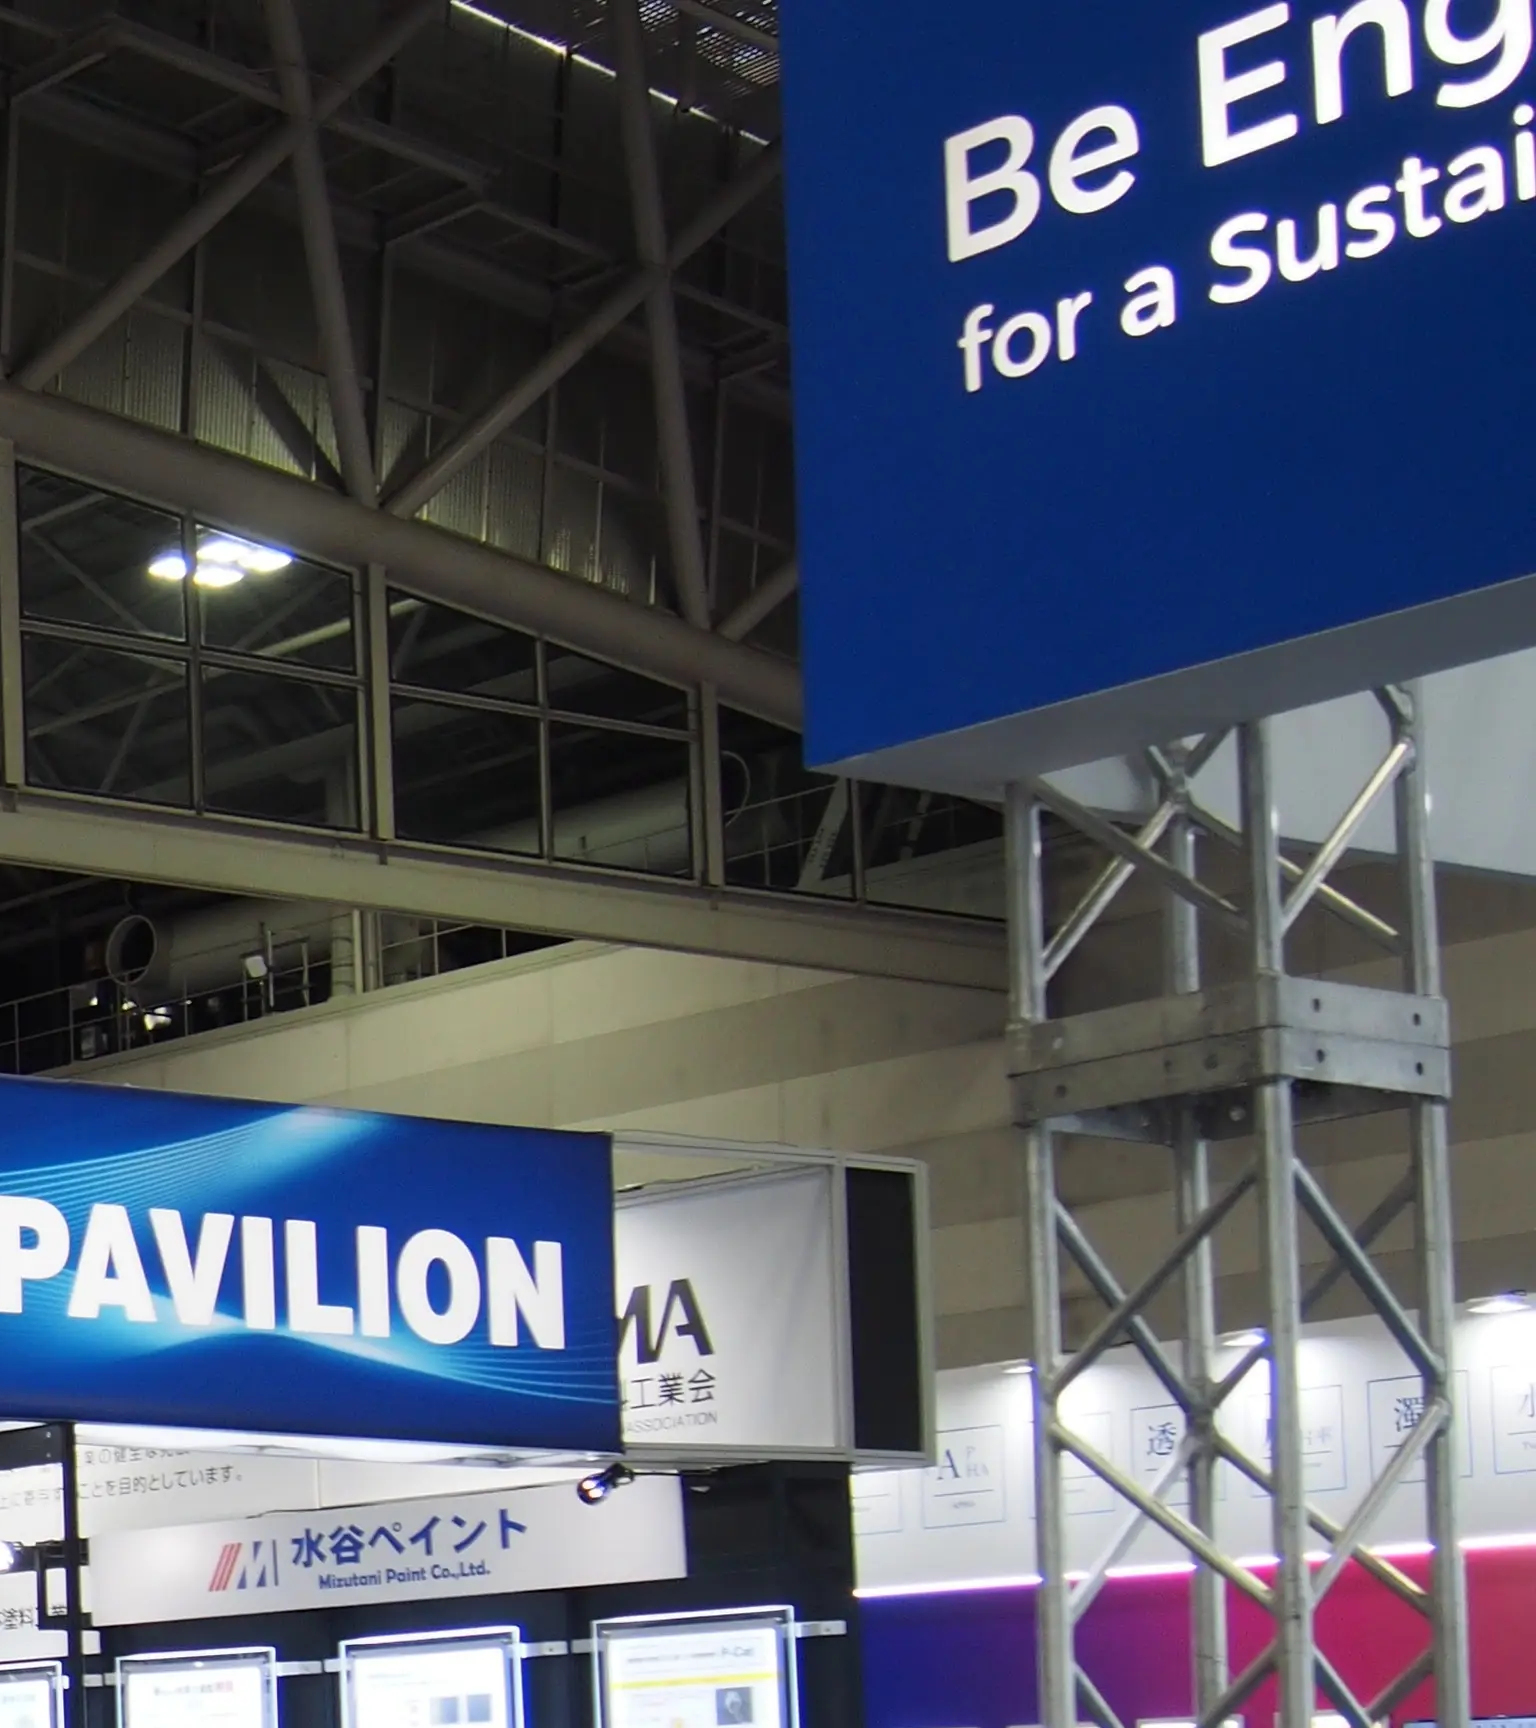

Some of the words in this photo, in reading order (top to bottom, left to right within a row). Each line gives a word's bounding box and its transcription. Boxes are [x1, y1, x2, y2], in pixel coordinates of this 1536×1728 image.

[944, 105, 1140, 262] Be
[1197, 0, 1533, 167] Eng
[957, 290, 1093, 392] for
[1120, 265, 1176, 337] a
[1208, 104, 1536, 304] Sustai
[622, 1368, 716, 1411] 工業会
[291, 1508, 528, 1568] 水谷ペイント
[319, 1570, 382, 1589] Mizutani
[386, 1567, 426, 1584] Paint
